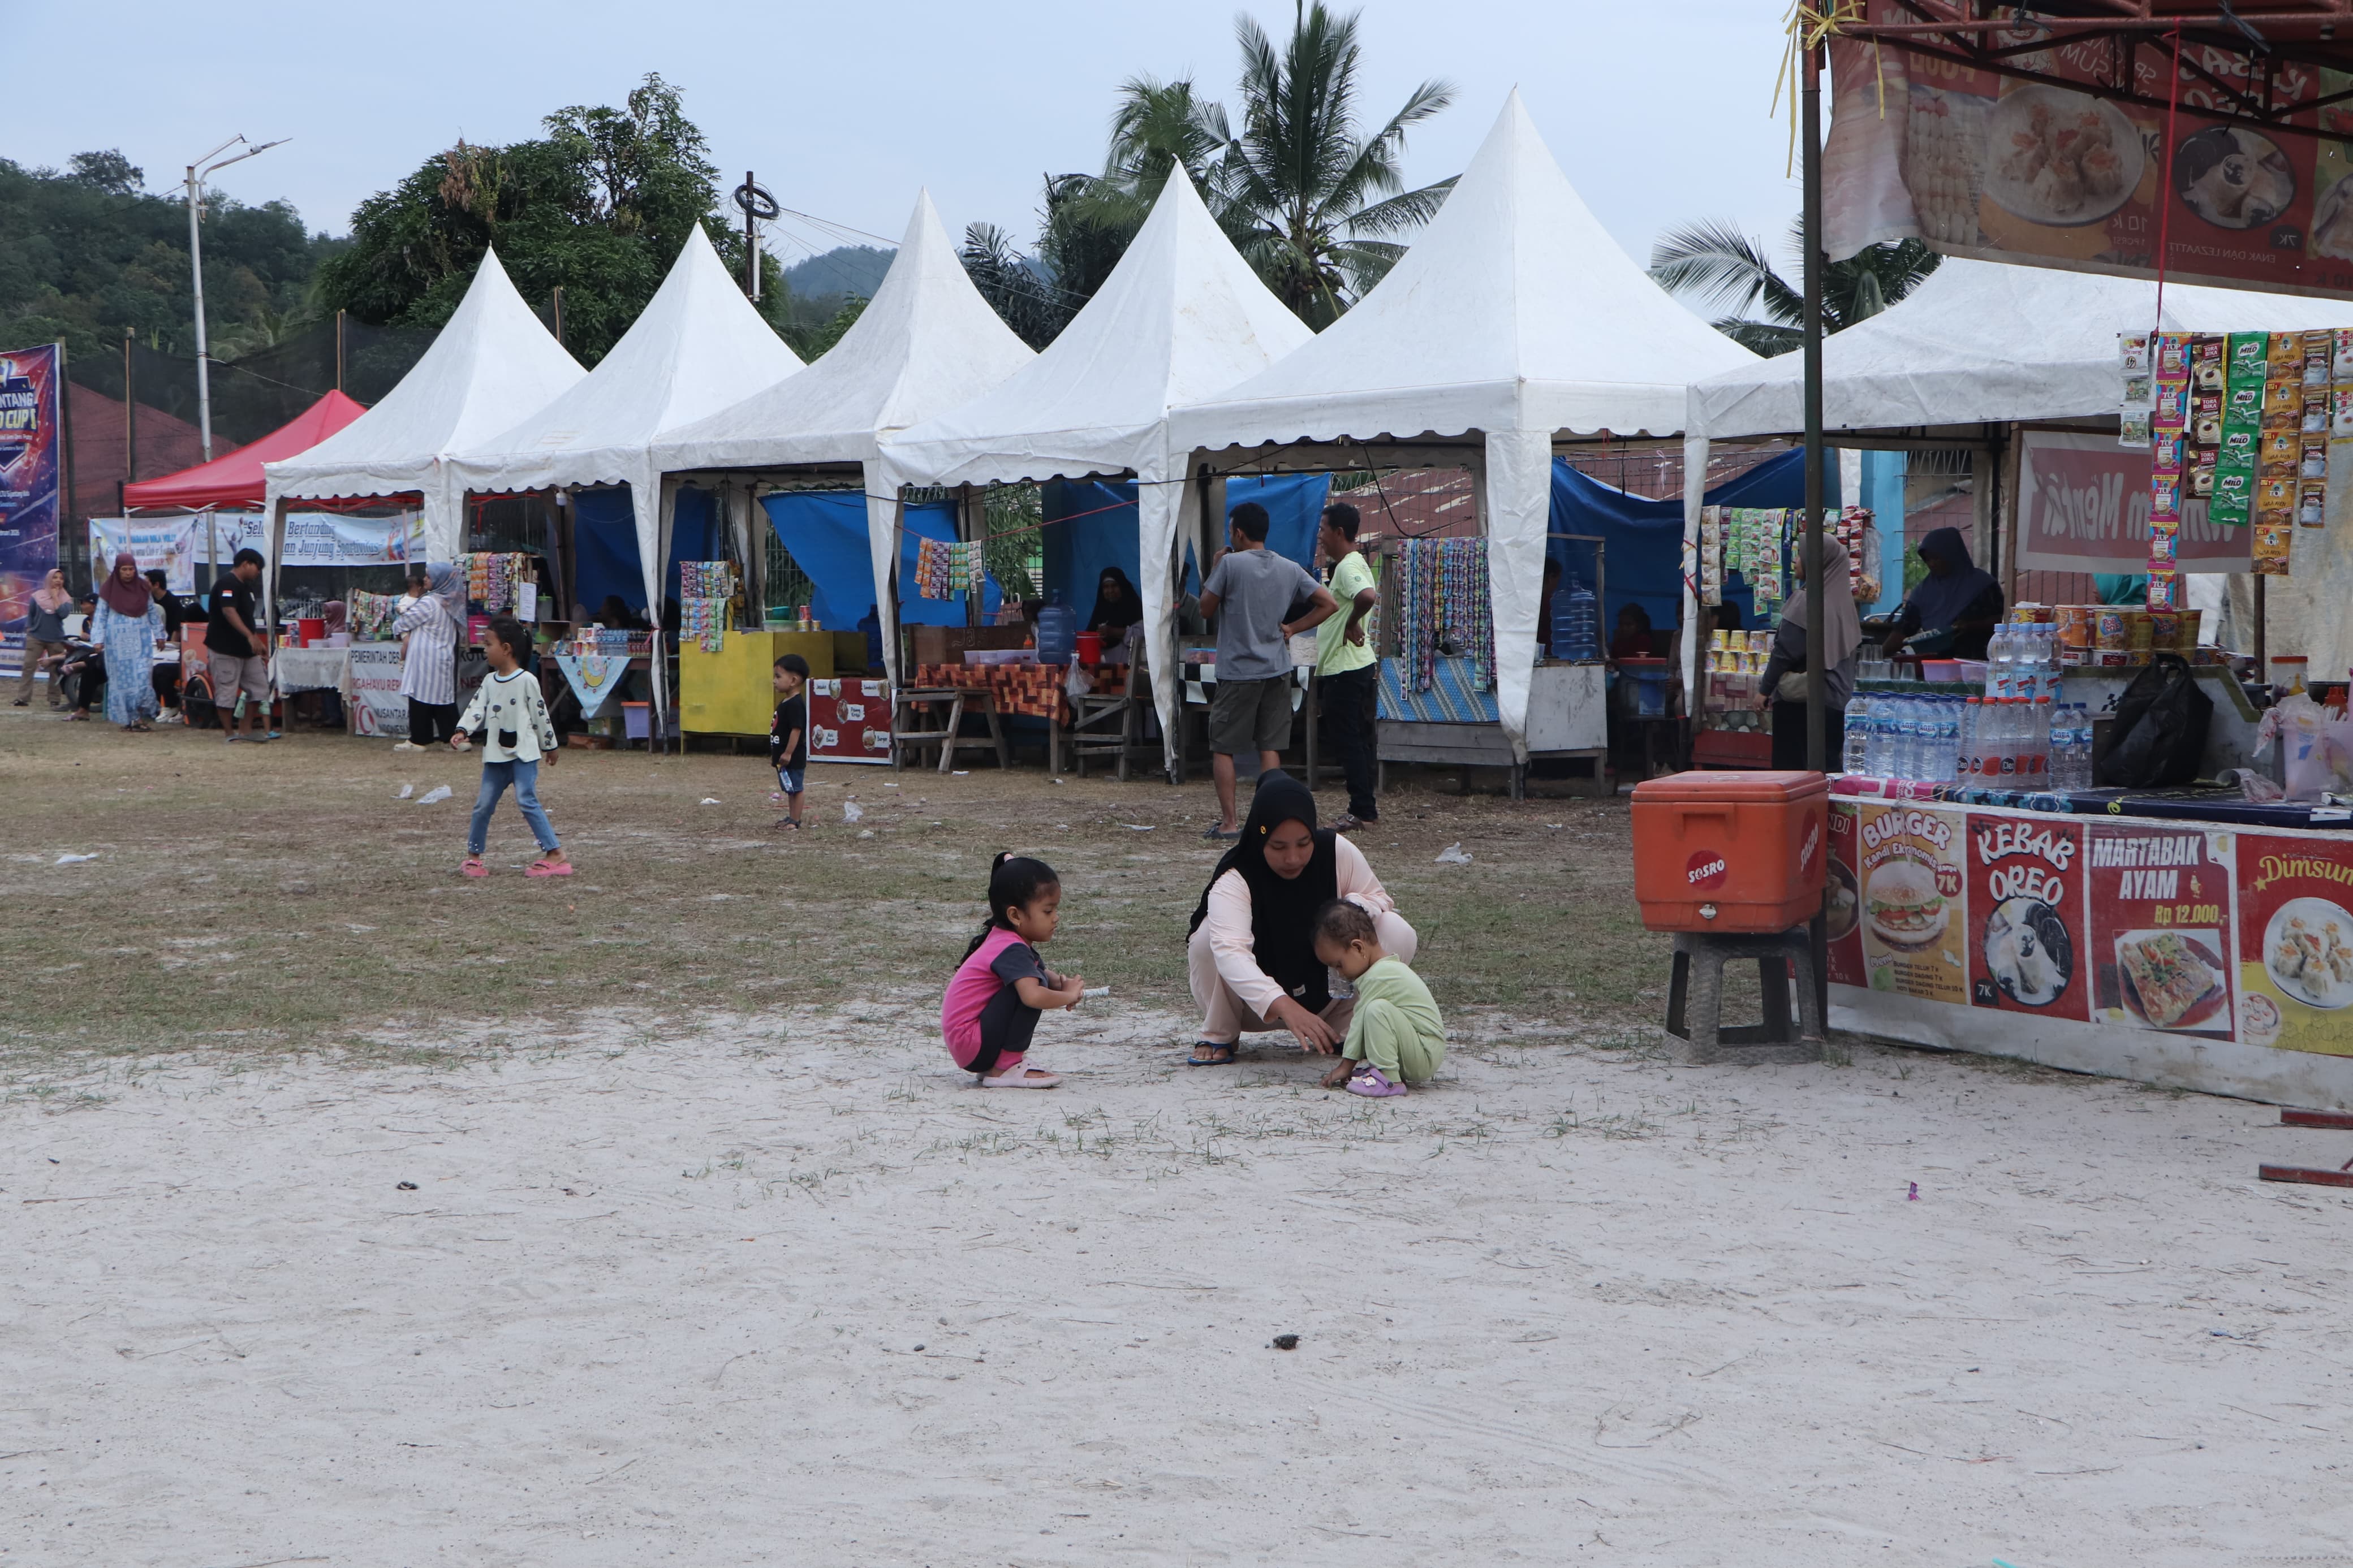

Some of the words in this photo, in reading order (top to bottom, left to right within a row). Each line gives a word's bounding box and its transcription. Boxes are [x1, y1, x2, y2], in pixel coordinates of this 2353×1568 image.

[2239, 345, 2257, 355] MILO
[6, 409, 28, 429] CUP
[299, 539, 334, 559] Junjung
[351, 650, 387, 664] PEMERINTAH
[389, 651, 400, 664] DES
[352, 678, 386, 691] RGAHAYU
[387, 679, 401, 691] REP
[1862, 811, 1951, 850] BURGER
[1864, 845, 1890, 869] Kandi
[1977, 823, 2075, 871] KEBAB
[2092, 836, 2201, 867] MARTABAK
[1688, 859, 1725, 883] SOSRO
[1937, 875, 1958, 892] 7K
[1989, 865, 2063, 906] OREO
[2119, 870, 2178, 899] AYAM
[2154, 905, 2171, 926] Rp
[1871, 952, 1893, 967] Menu
[1893, 961, 1912, 969] BURGER
[1894, 970, 1914, 978] BURGER
[1977, 984, 1992, 997] 7K
